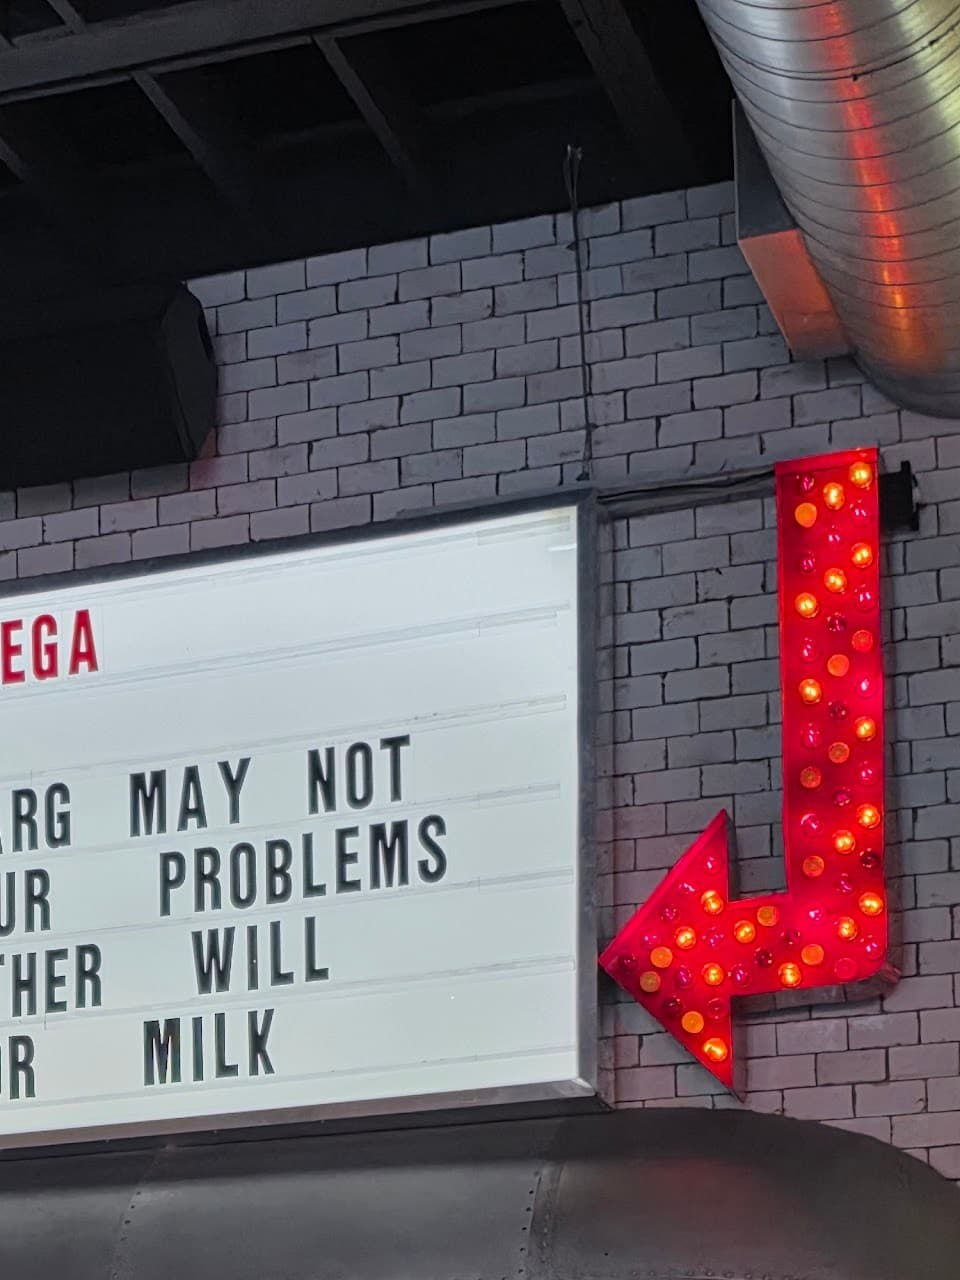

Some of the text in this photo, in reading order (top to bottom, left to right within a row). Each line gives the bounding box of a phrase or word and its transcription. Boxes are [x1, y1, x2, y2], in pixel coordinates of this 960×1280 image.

[129, 757, 252, 837] MAY
[307, 734, 411, 815] NOT
[159, 814, 447, 917] PROBLEMS
[191, 916, 329, 995] WILL
[143, 1008, 275, 1086] MILK
